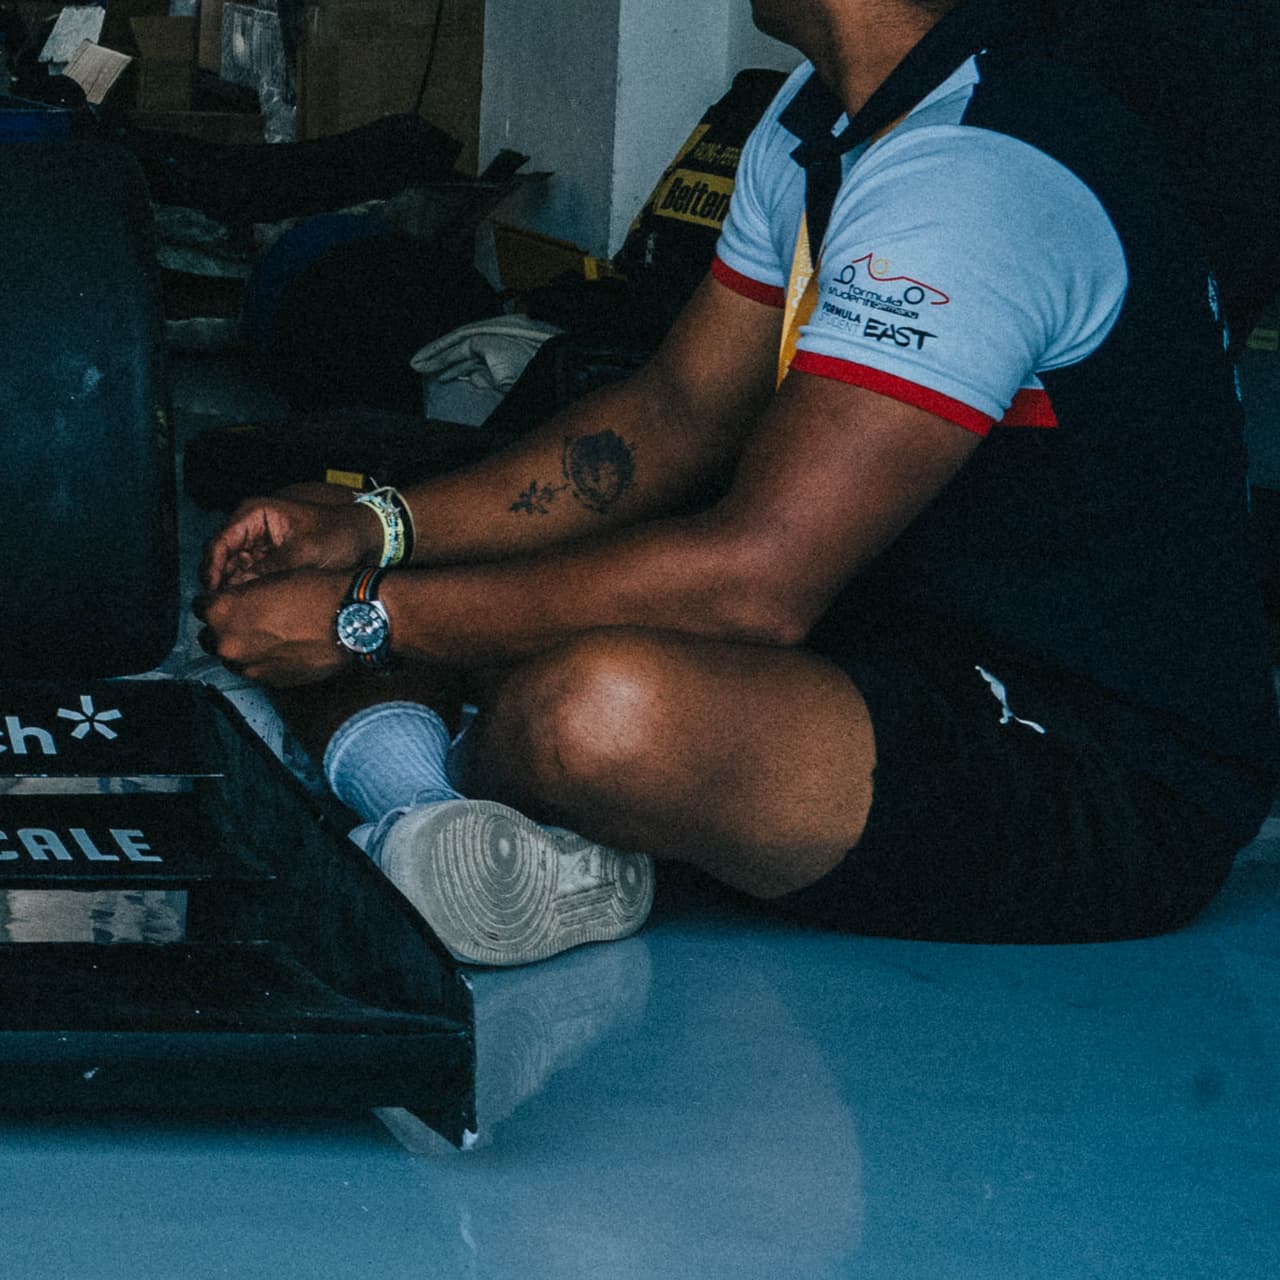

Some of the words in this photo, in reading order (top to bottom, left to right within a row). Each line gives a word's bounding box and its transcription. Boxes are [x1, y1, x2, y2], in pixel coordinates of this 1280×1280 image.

[849, 284, 903, 307] formula
[822, 301, 862, 323] FORMULA
[864, 317, 938, 350] EAST
